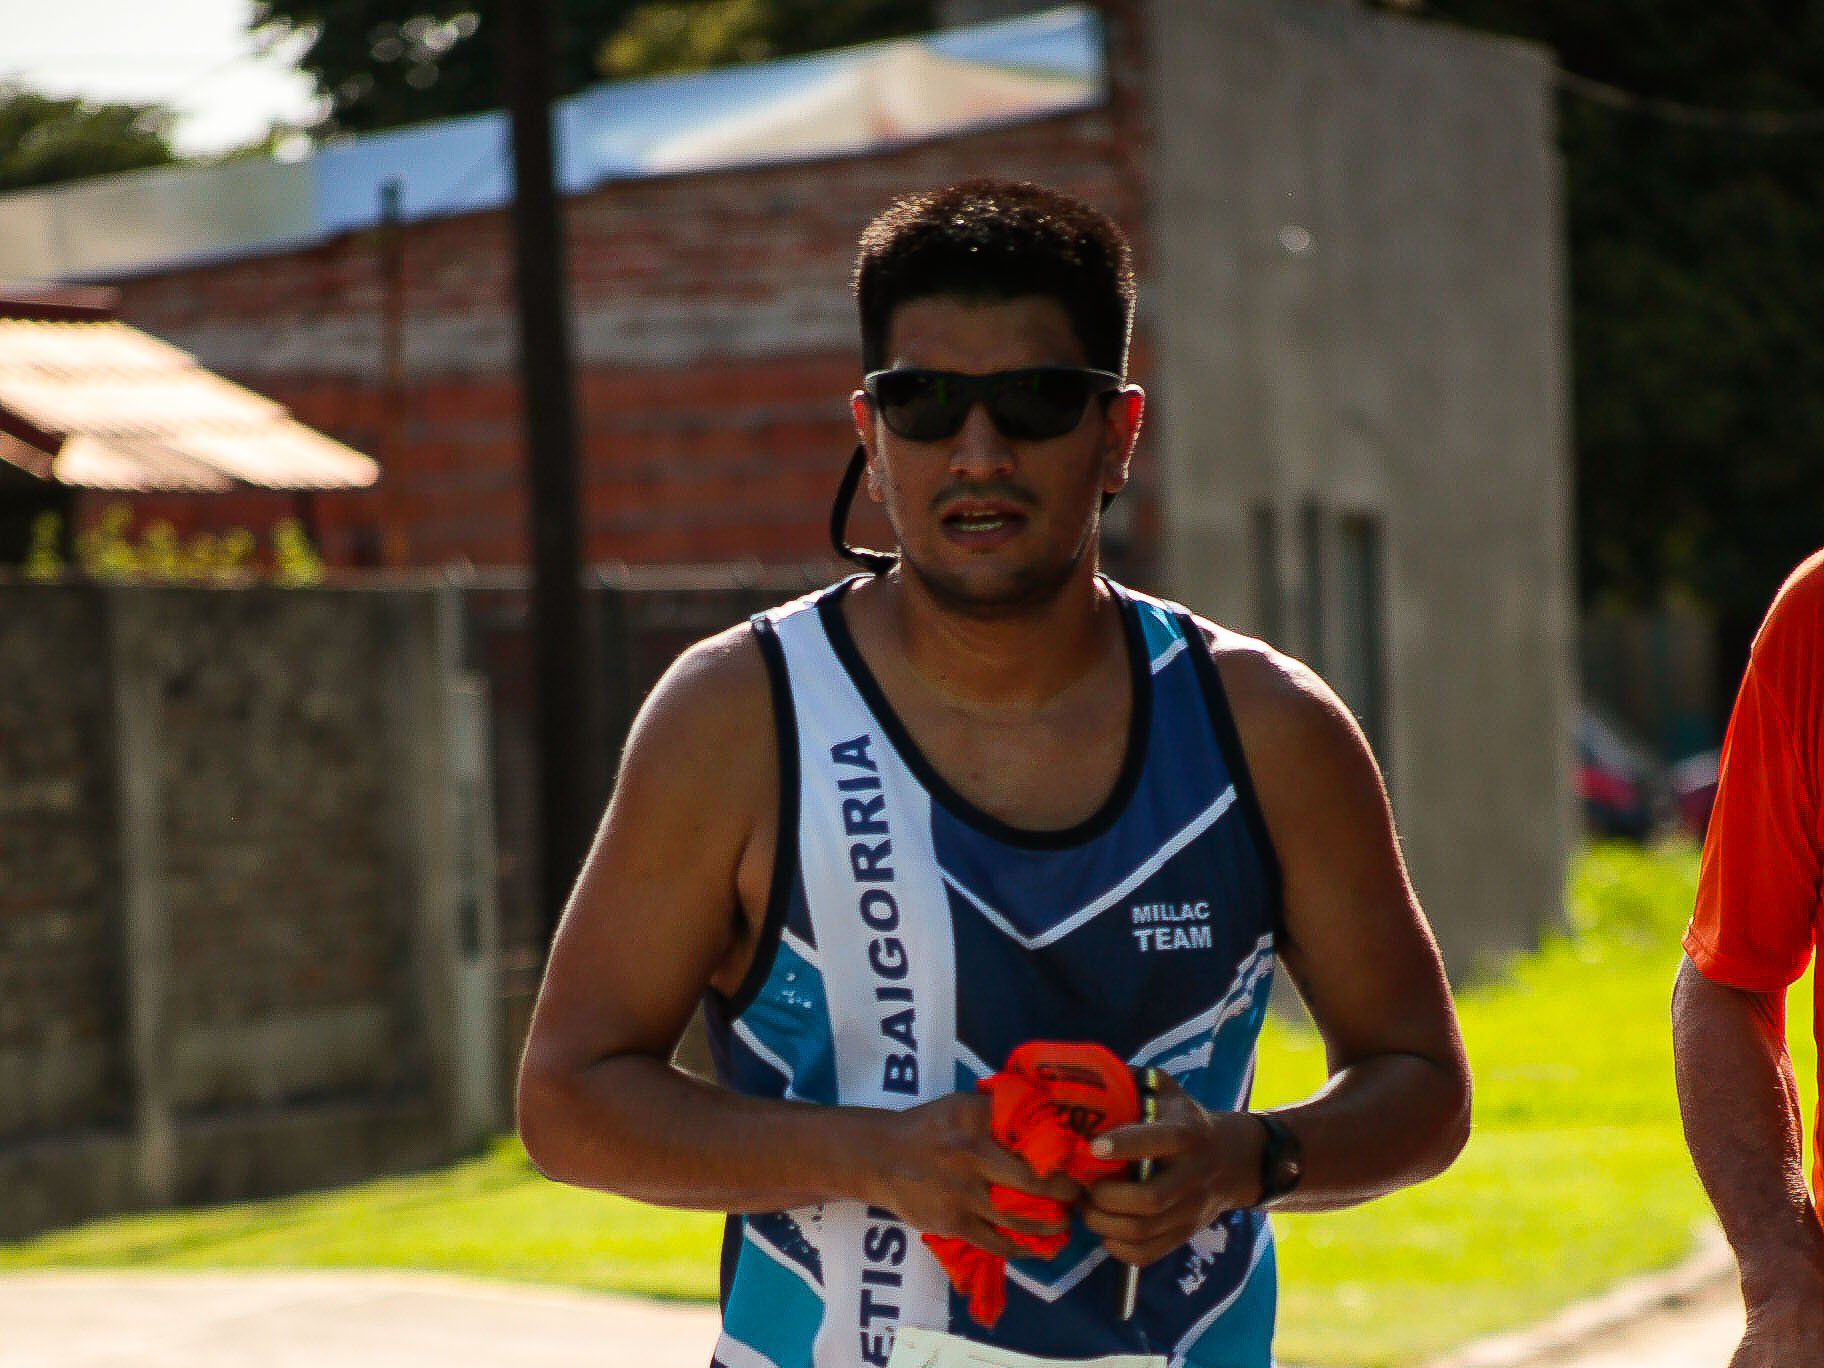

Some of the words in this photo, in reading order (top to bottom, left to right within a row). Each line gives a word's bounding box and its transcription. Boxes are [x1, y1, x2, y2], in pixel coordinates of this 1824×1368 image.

[830, 734, 919, 1096] BAIGORRIA
[1132, 902, 1210, 924] MILLAC
[1132, 926, 1212, 952] TEAM
